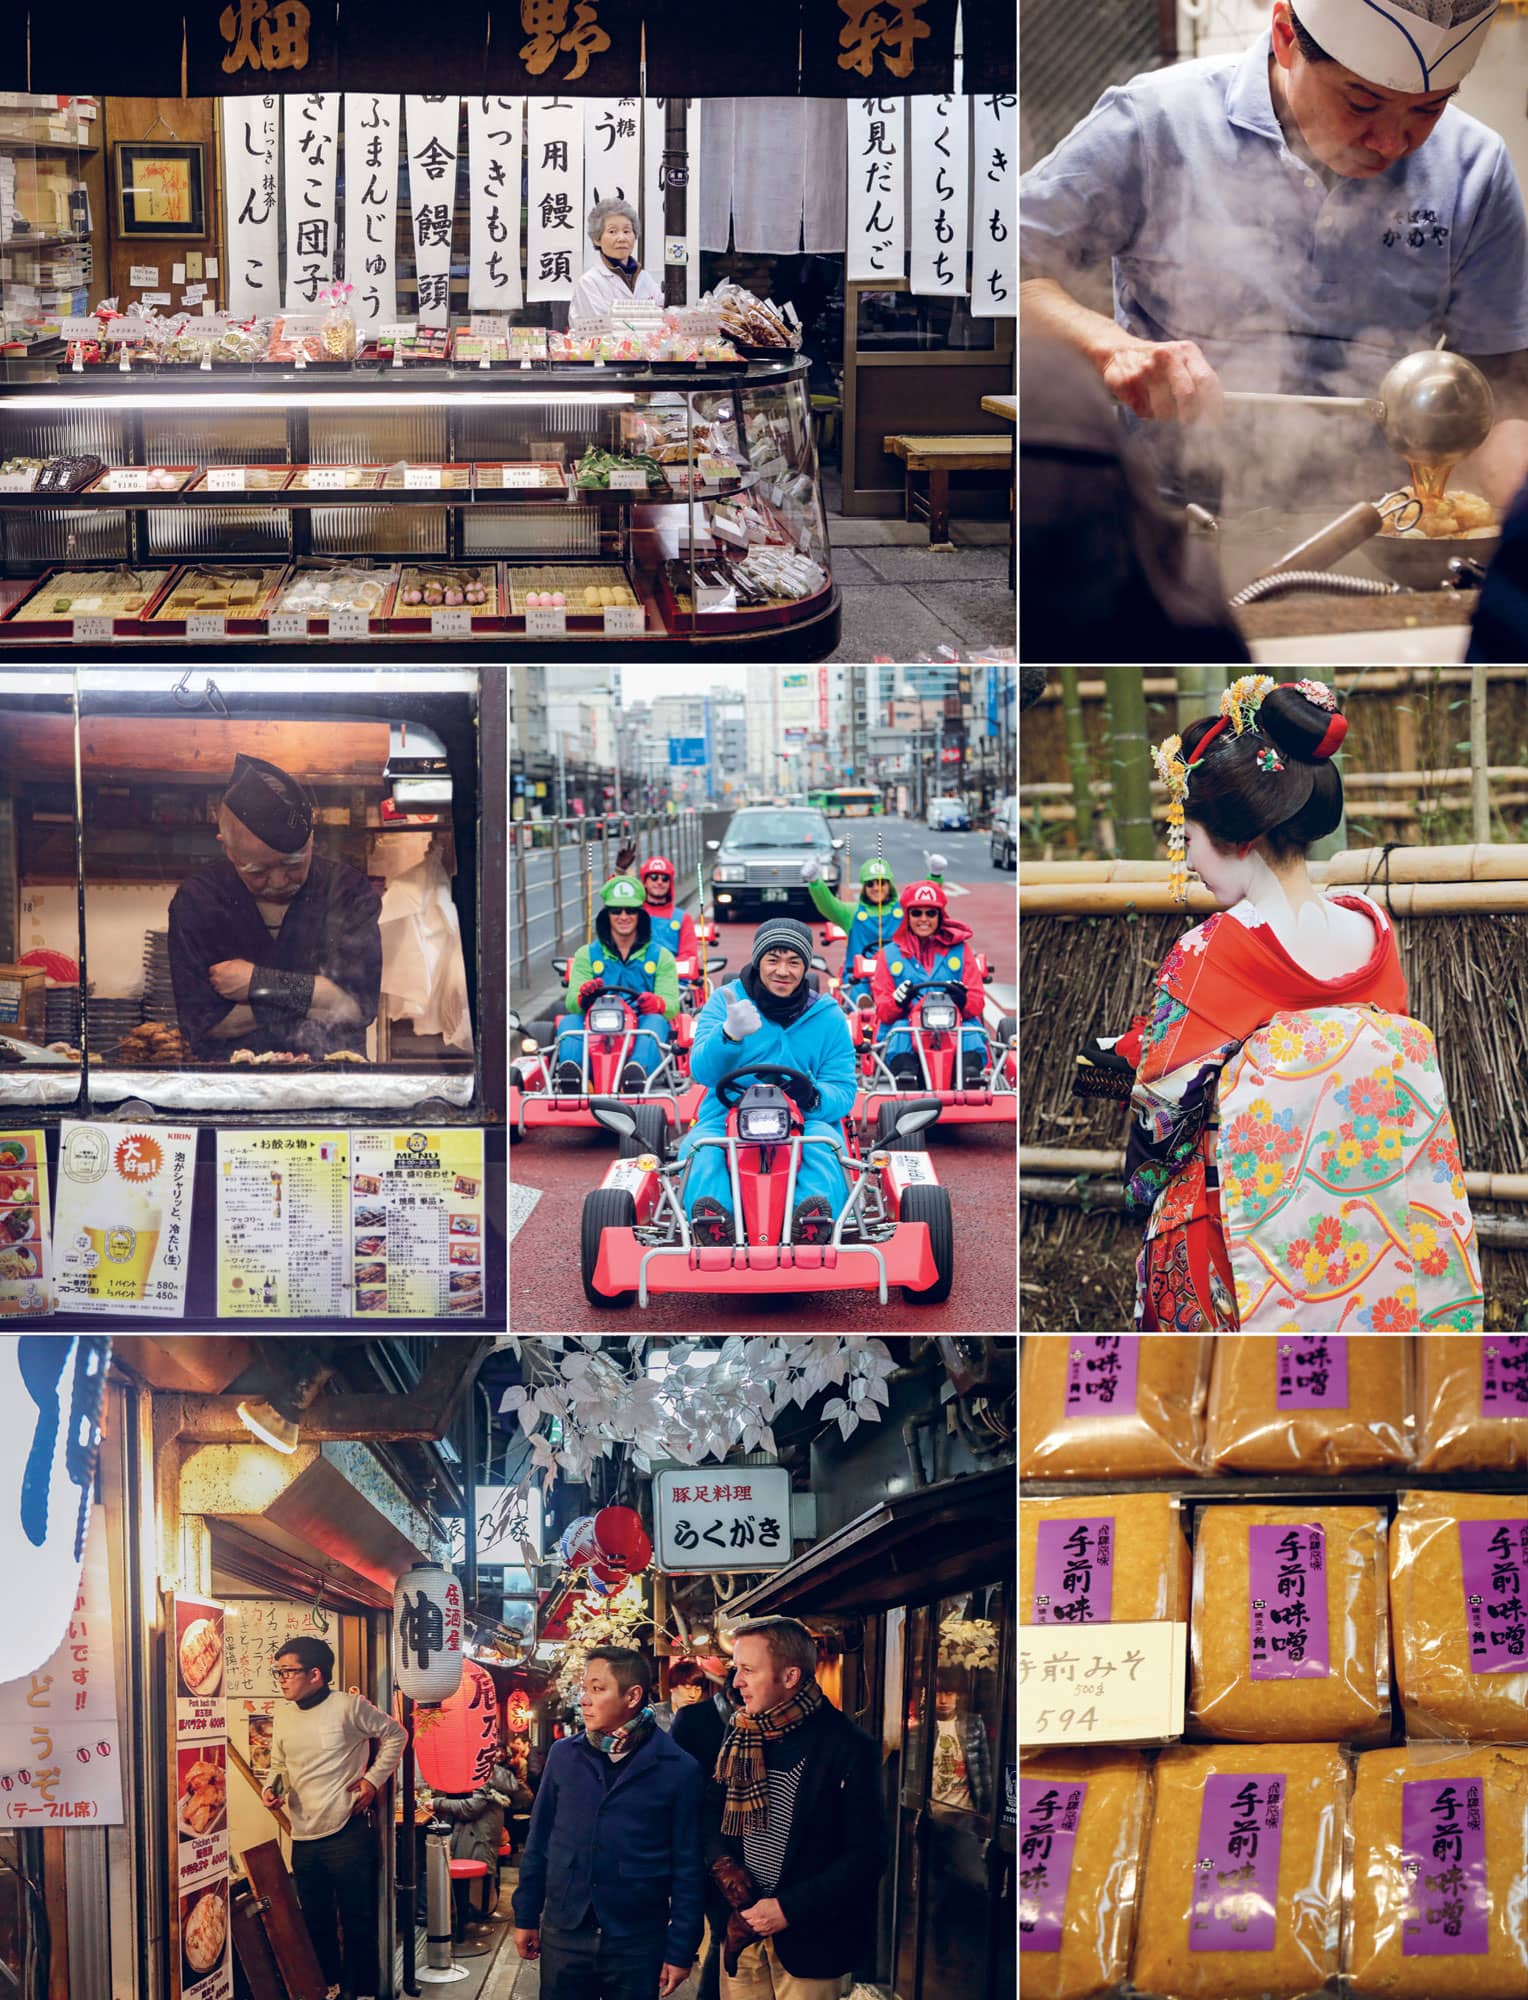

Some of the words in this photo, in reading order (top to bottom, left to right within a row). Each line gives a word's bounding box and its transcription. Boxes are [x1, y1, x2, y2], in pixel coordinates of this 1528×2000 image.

[1383, 227, 1449, 248] かめや
[619, 885, 628, 896] L
[919, 889, 934, 900] M
[167, 1133, 192, 1141] KIRIN
[1296, 1336, 1332, 1396] 味噌
[672, 1484, 753, 1503] 豚足料理
[674, 1516, 781, 1549] らくがき
[1270, 1531, 1311, 1662] 手前味噌
[1487, 1526, 1528, 1656] 手前味噌
[444, 1583, 461, 1652] 居酒屋
[26, 1674, 61, 1800] どうぞ
[1036, 1705, 1100, 1733] 594
[1019, 1789, 1064, 1933] 手前味
[1424, 1787, 1468, 1937] 手前味噌
